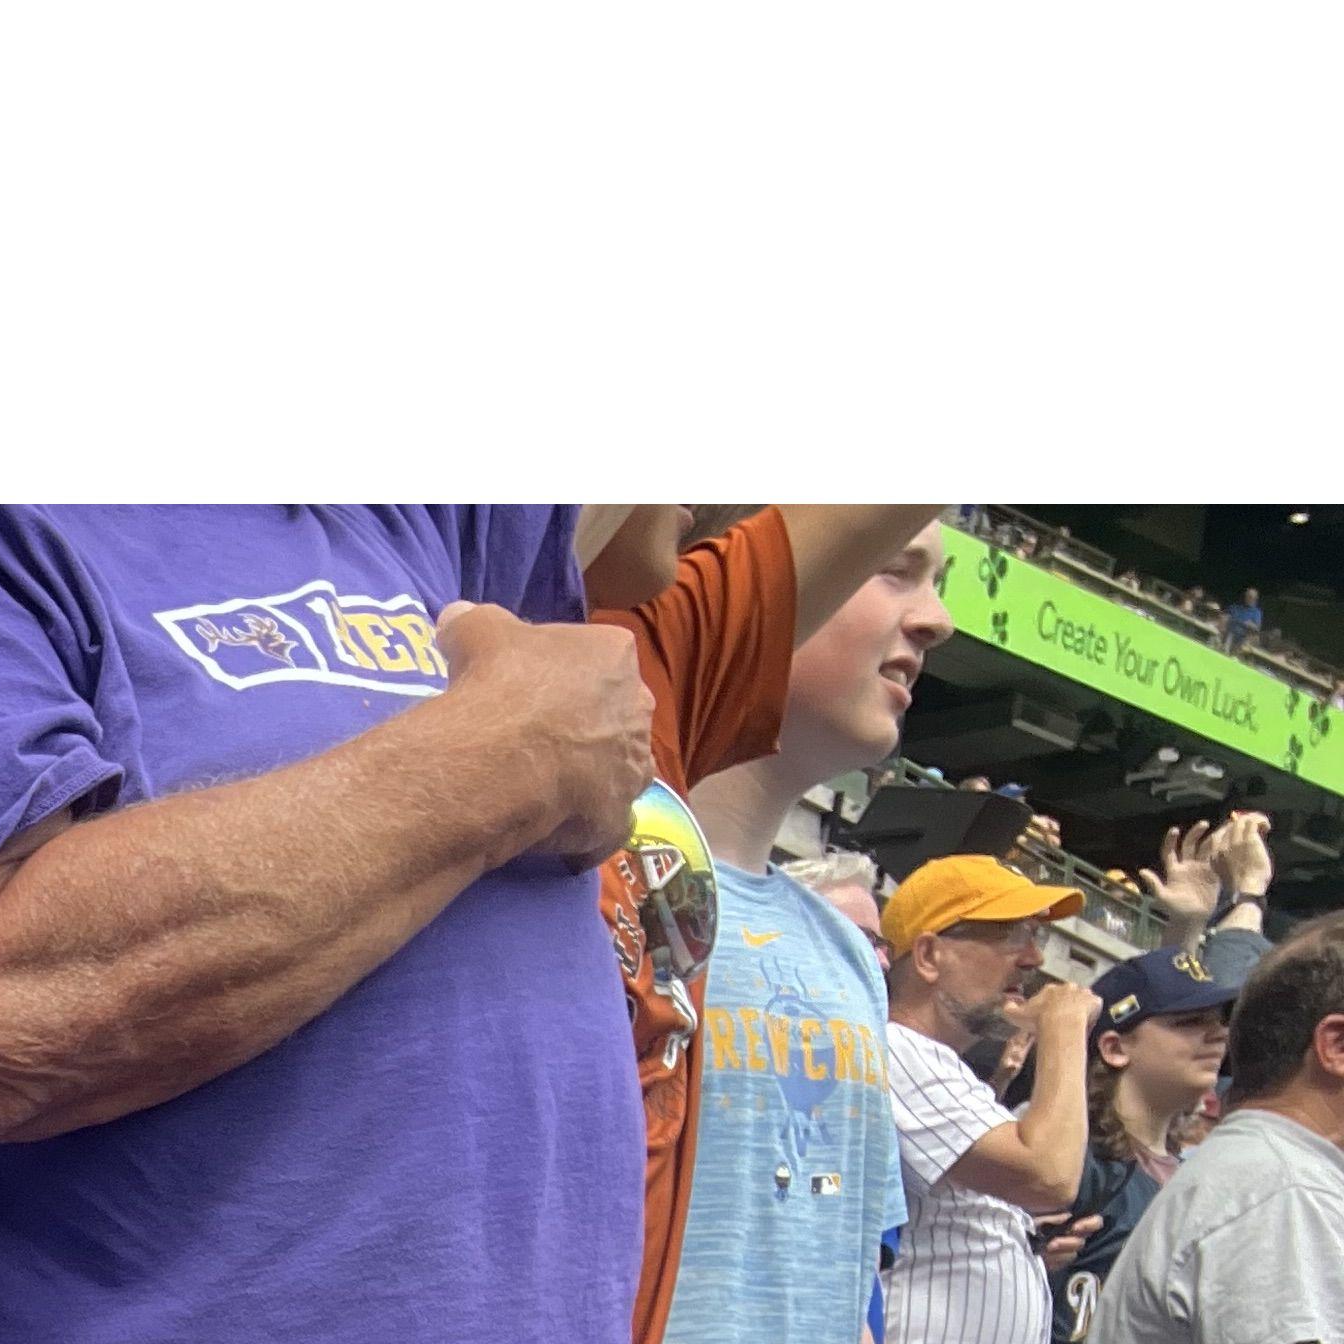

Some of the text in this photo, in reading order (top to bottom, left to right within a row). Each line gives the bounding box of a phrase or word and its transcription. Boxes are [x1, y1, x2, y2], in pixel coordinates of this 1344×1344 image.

[1036, 600, 1109, 666] Create
[1113, 629, 1160, 684] Your
[1162, 655, 1210, 712] Own
